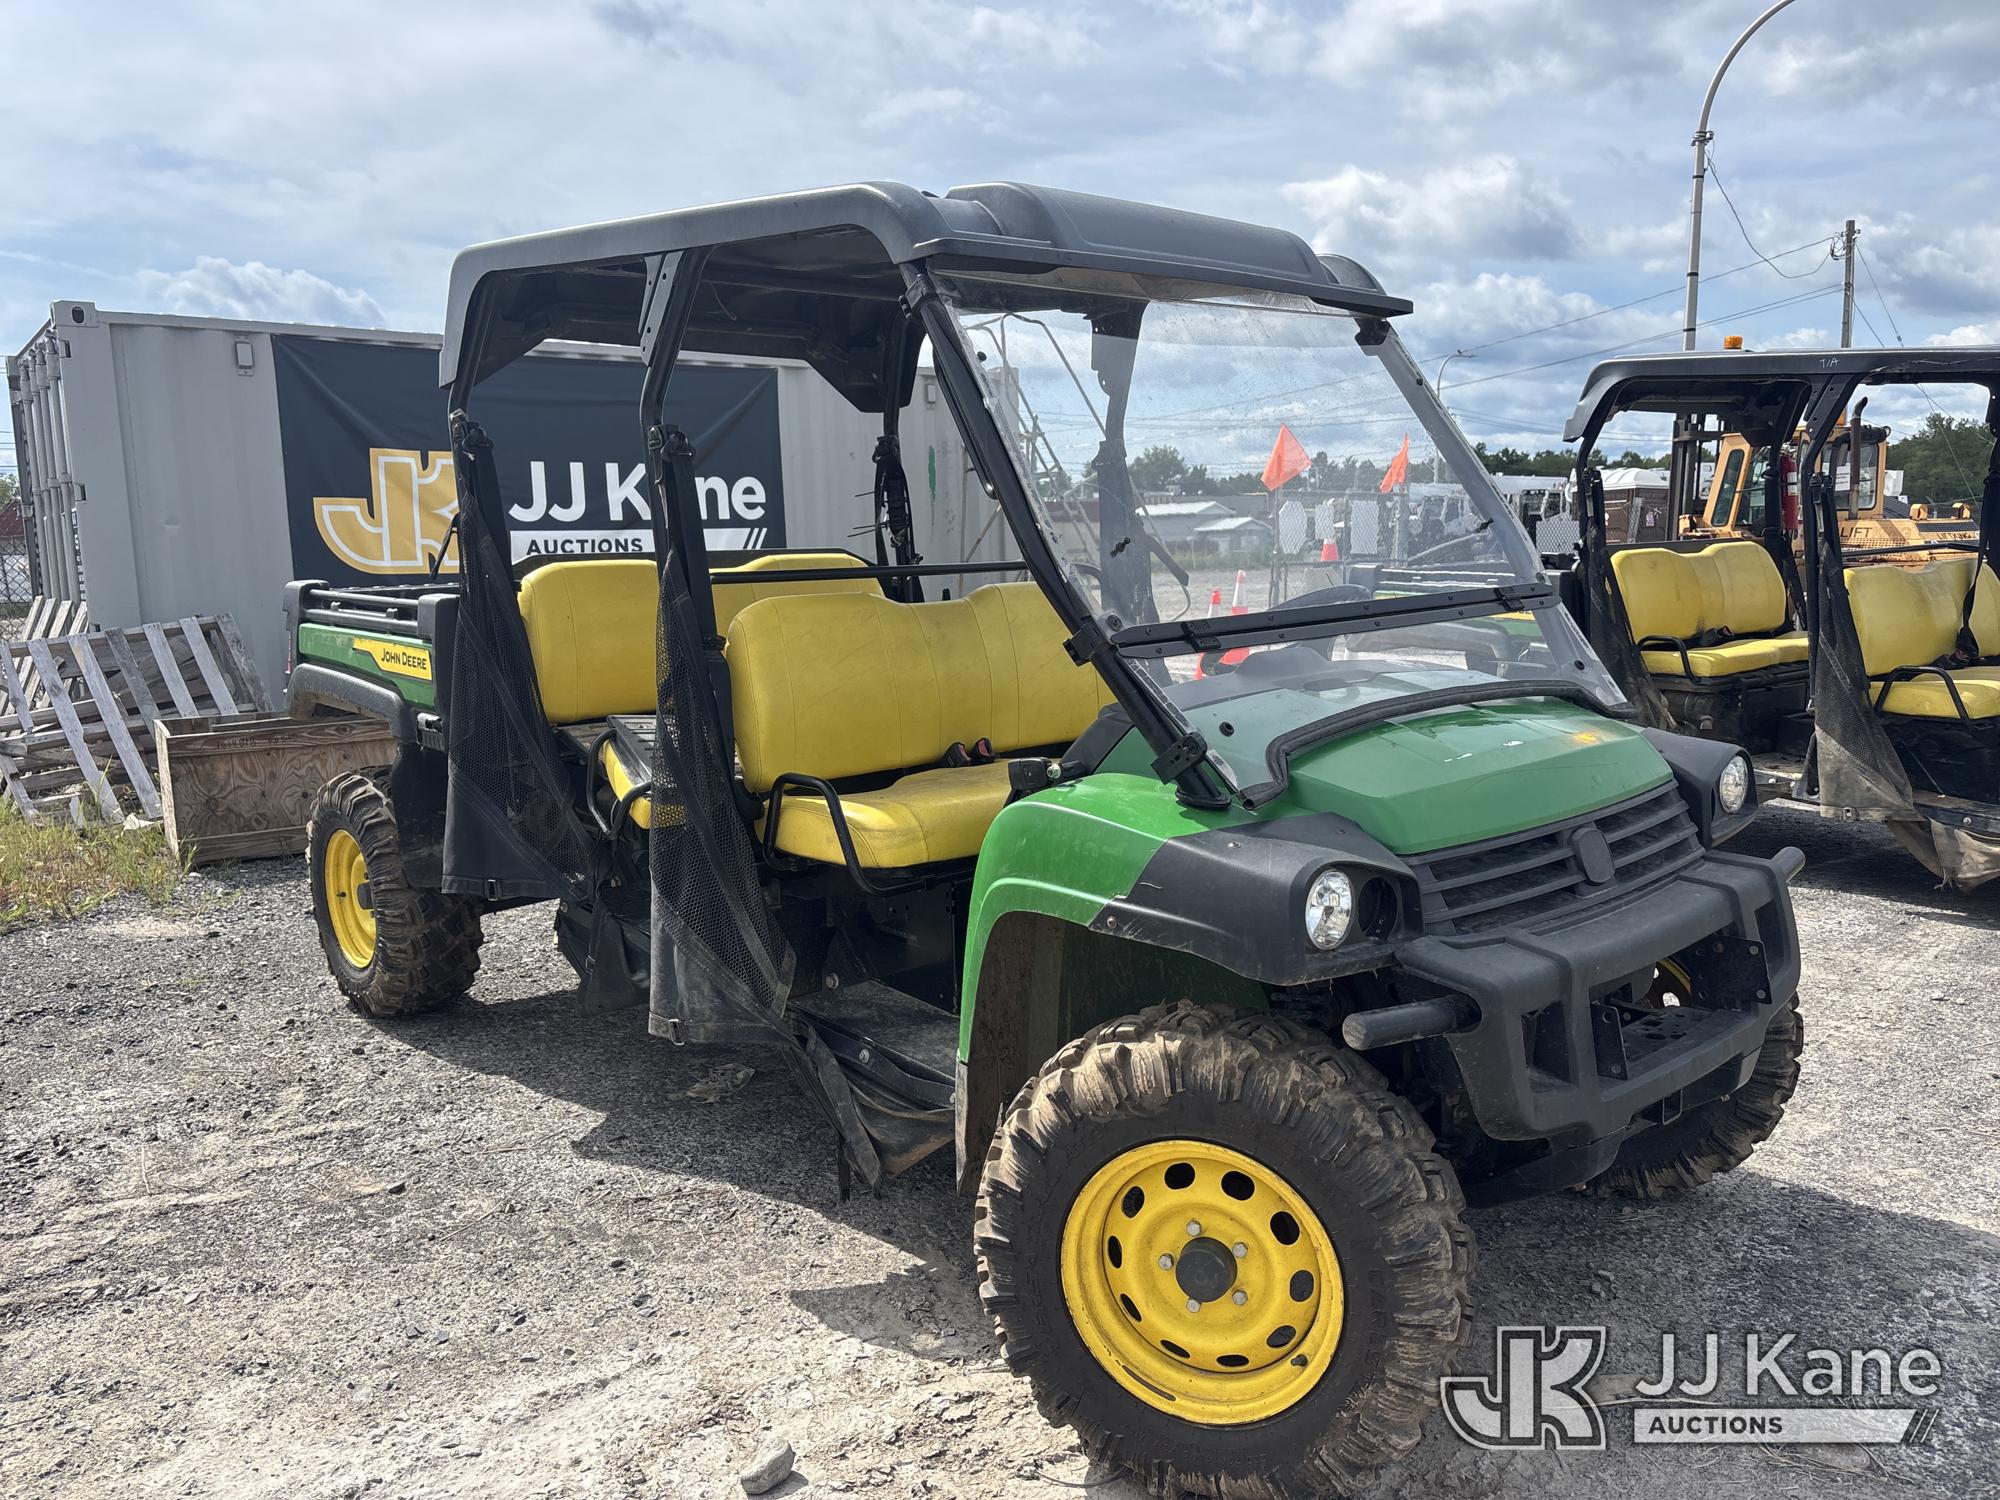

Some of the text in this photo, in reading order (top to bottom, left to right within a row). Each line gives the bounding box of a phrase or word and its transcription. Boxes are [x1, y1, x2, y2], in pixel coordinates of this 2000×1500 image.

[508, 460, 767, 523] JJ Kne
[1840, 526, 1873, 538] LIFT
[526, 537, 644, 555] AUCTIONS
[381, 648, 427, 670] JOHN DEERE
